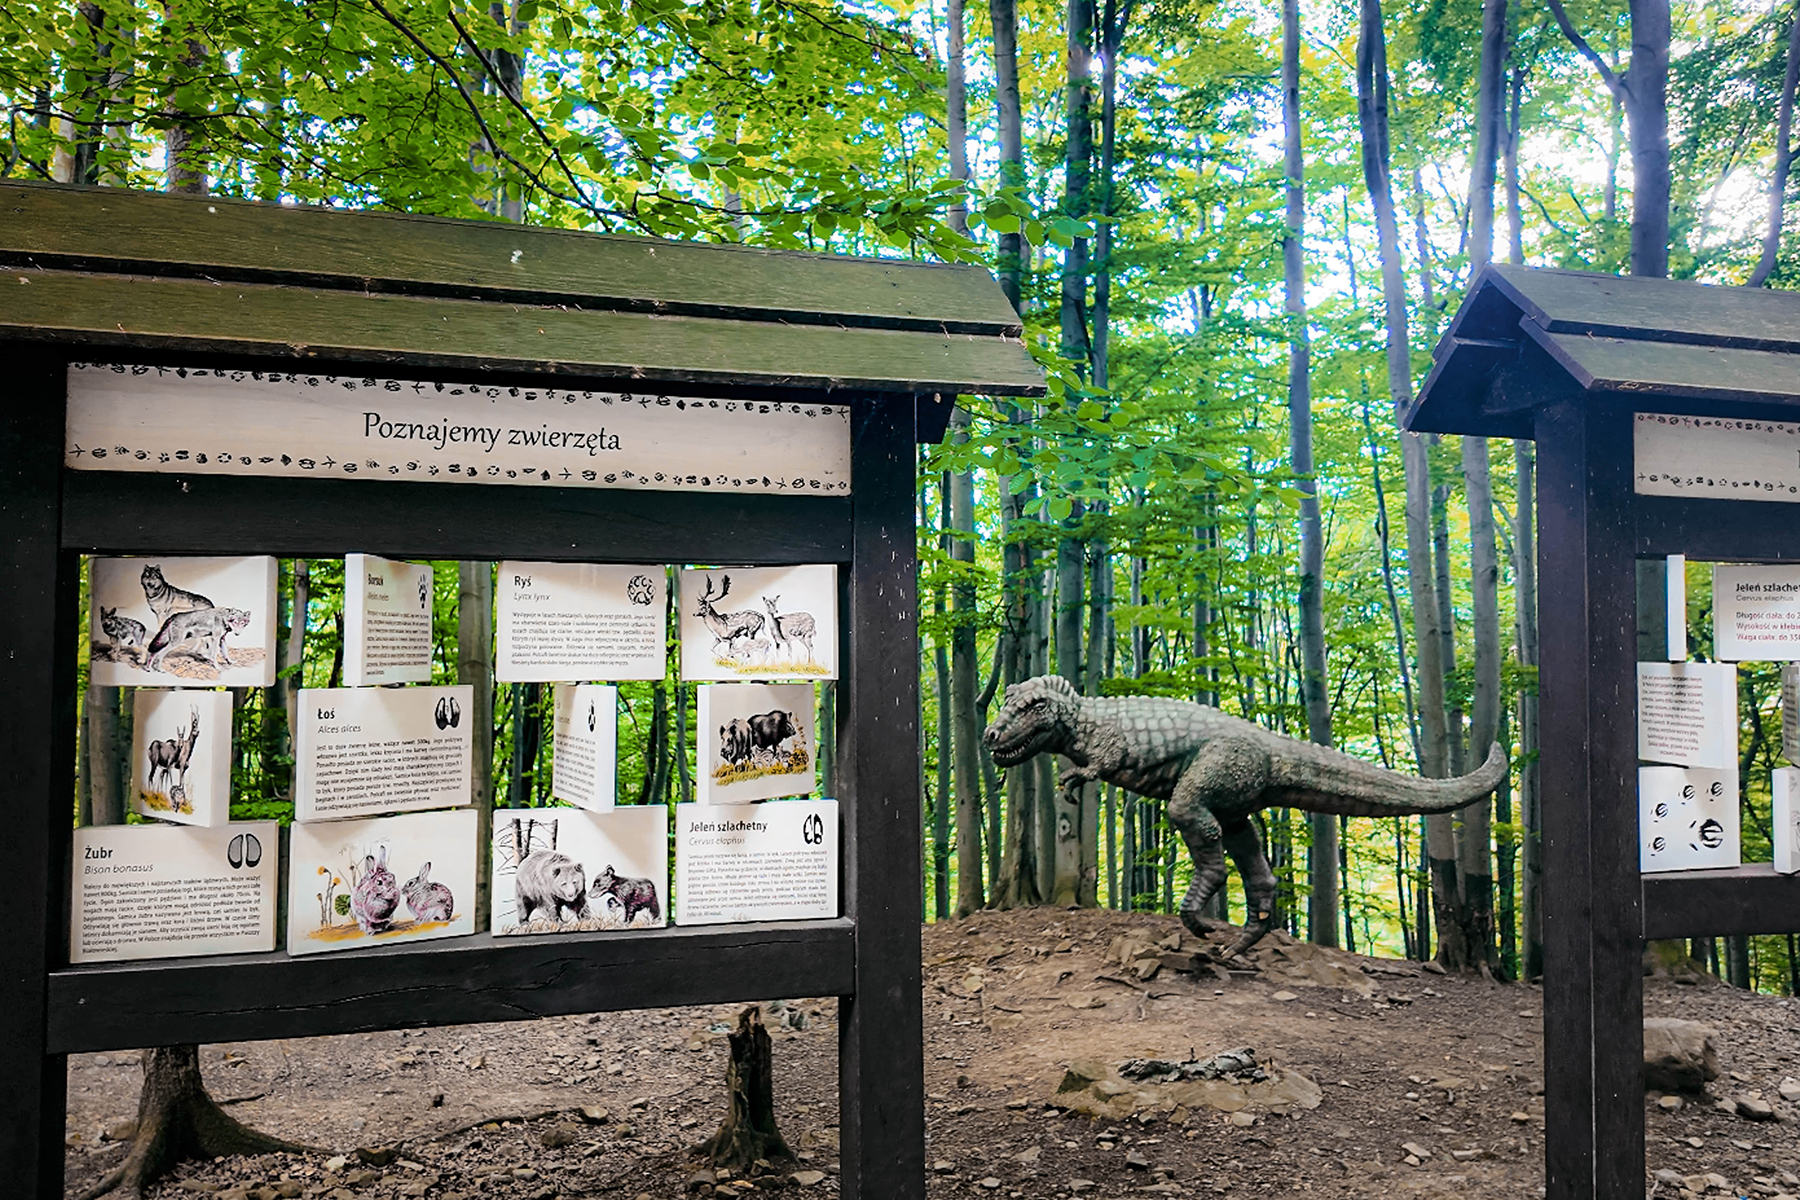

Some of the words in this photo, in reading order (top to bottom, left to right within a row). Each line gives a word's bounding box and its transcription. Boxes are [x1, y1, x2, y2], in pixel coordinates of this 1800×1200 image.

[363, 412, 500, 452] Poznajemy
[508, 424, 622, 456] zwierzęta
[514, 575, 532, 589] Ryś
[1736, 582, 1761, 592] Jeleń
[1763, 582, 1800, 592] szlache
[514, 592, 532, 602] Lynx
[534, 593, 550, 603] lynx
[1736, 612, 1764, 621] Długość
[1786, 612, 1796, 620] do
[1736, 622, 1771, 631] Wysokość
[1736, 633, 1757, 643] Waga
[318, 707, 335, 720] Łoś
[318, 725, 339, 734] Alces
[341, 723, 361, 733] alces
[689, 821, 715, 833] Jeleń
[717, 820, 768, 833] szlachetny
[85, 844, 113, 859] Żubr
[84, 865, 111, 875] Bison
[113, 864, 154, 874] bonasus
